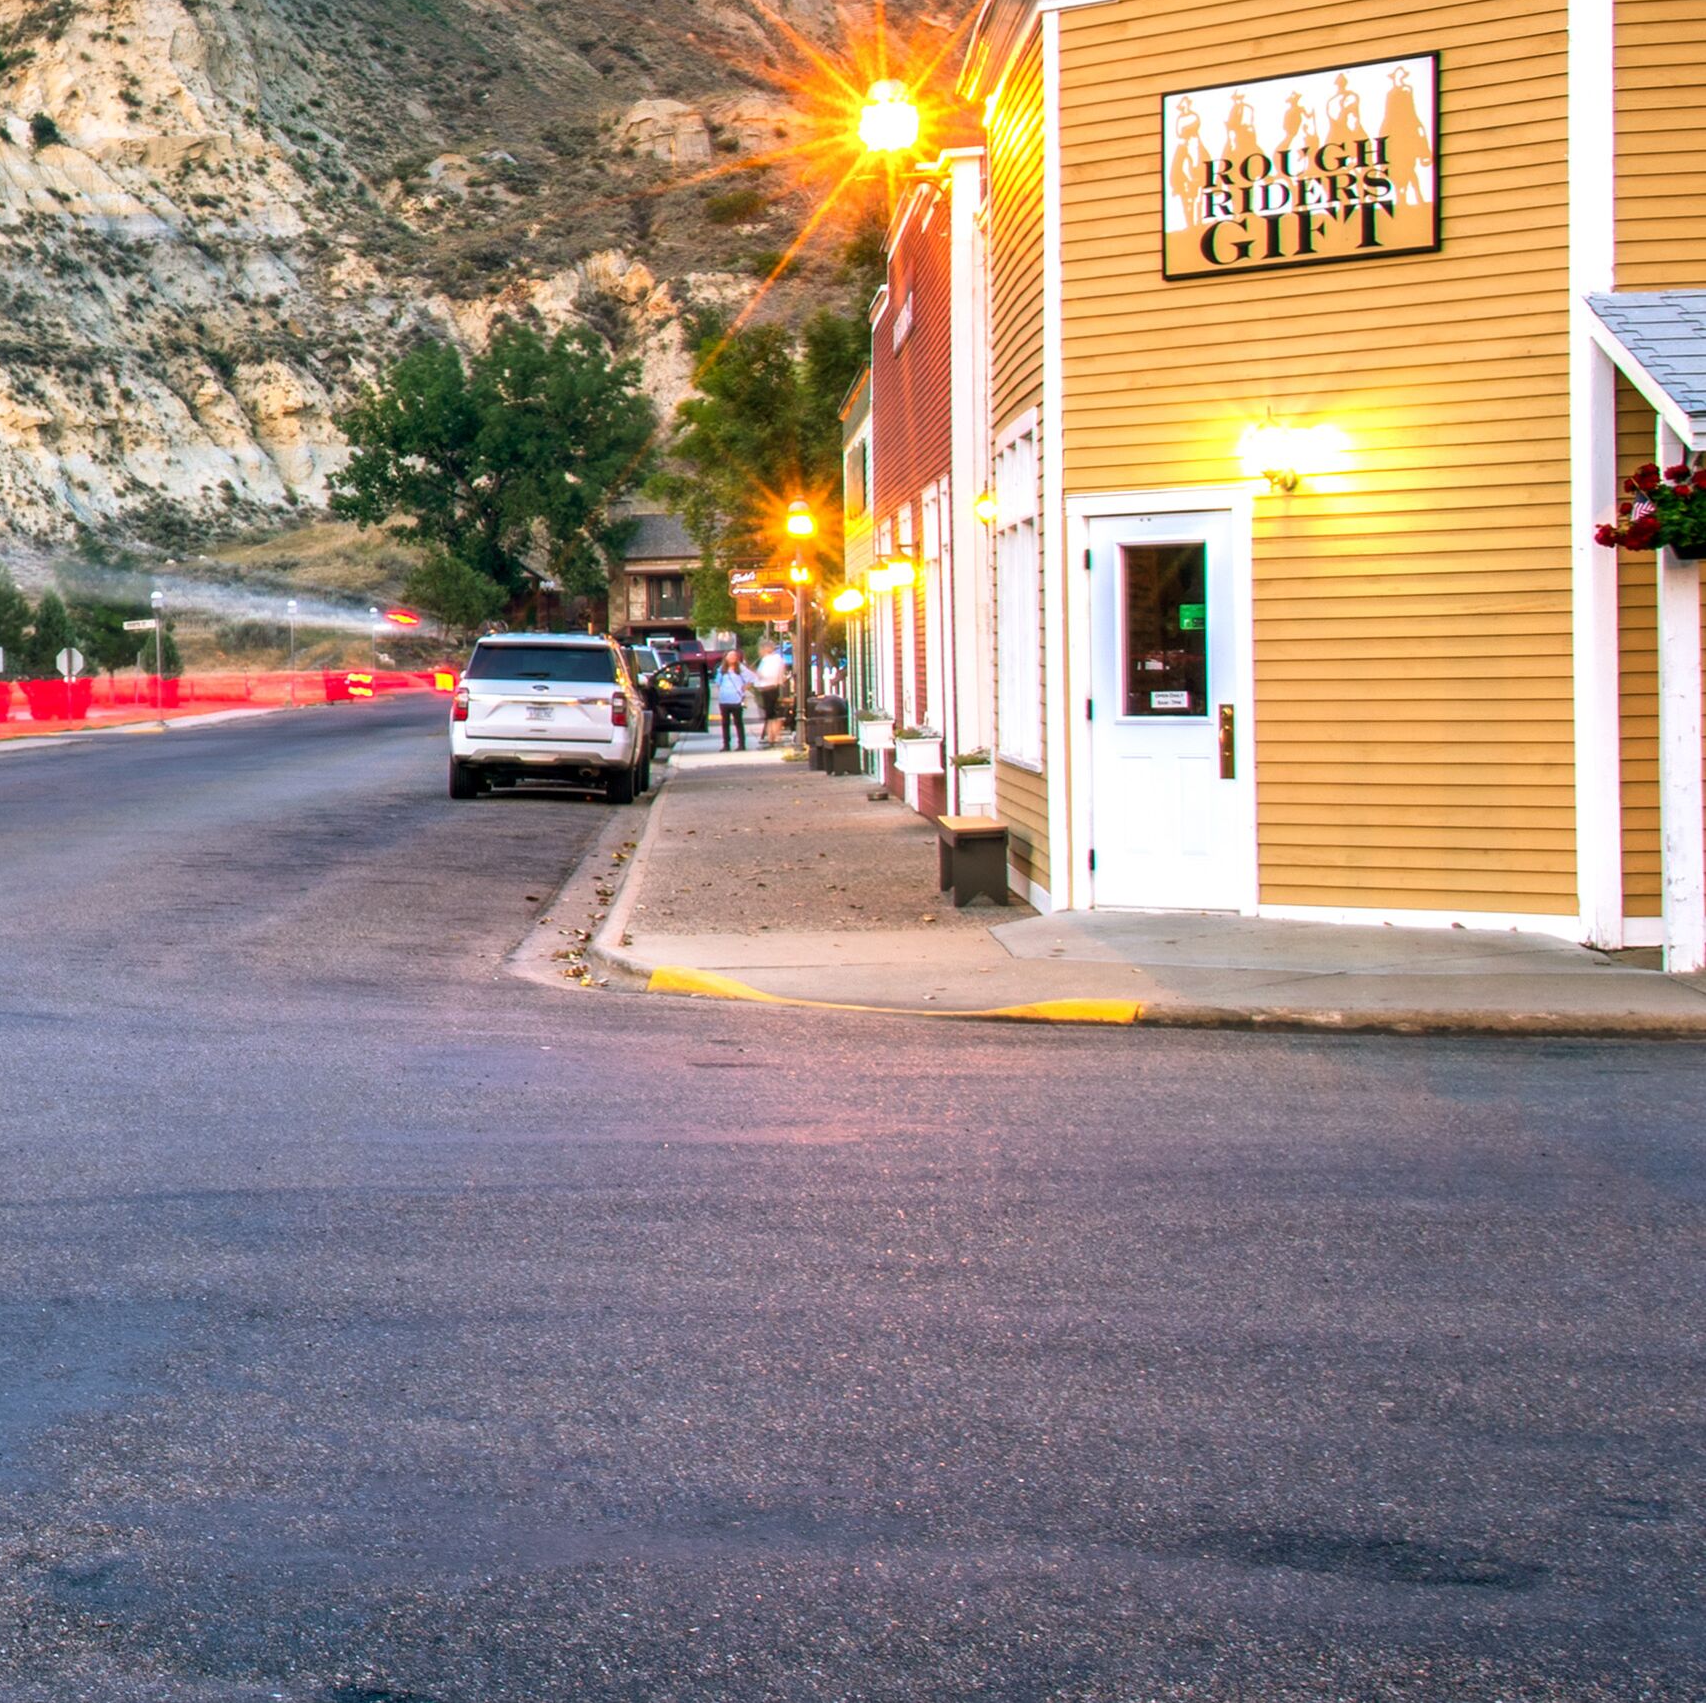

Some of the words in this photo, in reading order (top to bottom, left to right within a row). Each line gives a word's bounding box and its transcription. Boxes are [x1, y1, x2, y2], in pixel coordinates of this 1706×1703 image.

[1203, 136, 1390, 189] ROUGH
[1203, 168, 1392, 219] RIDERS
[1200, 200, 1395, 265] GIFT
